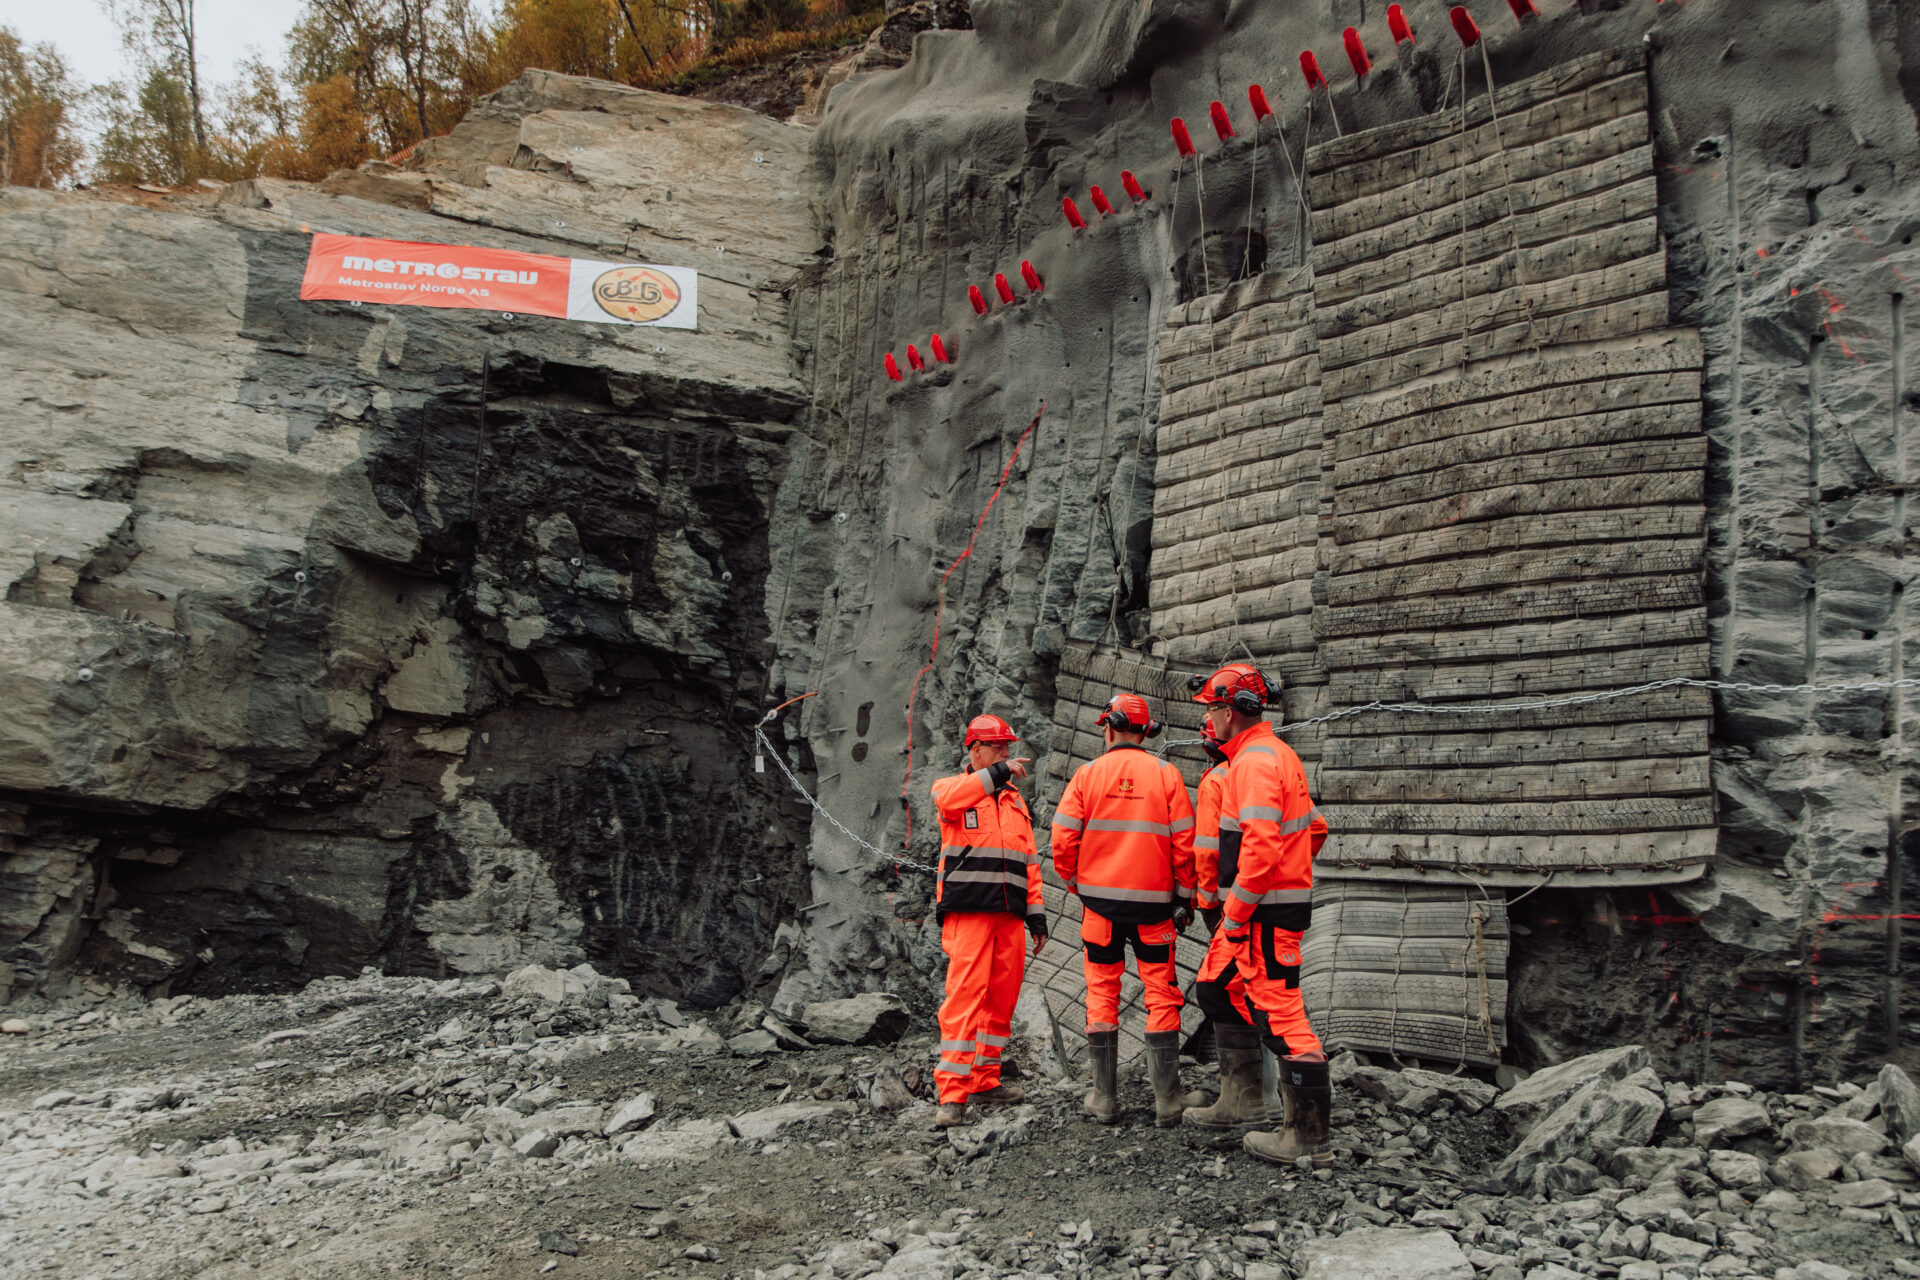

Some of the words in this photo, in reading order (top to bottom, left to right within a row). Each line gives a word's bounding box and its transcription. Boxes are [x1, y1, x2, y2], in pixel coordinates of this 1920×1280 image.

[338, 276, 416, 291] Metrostav
[420, 283, 466, 295] Norge
[469, 287, 491, 297] AS
